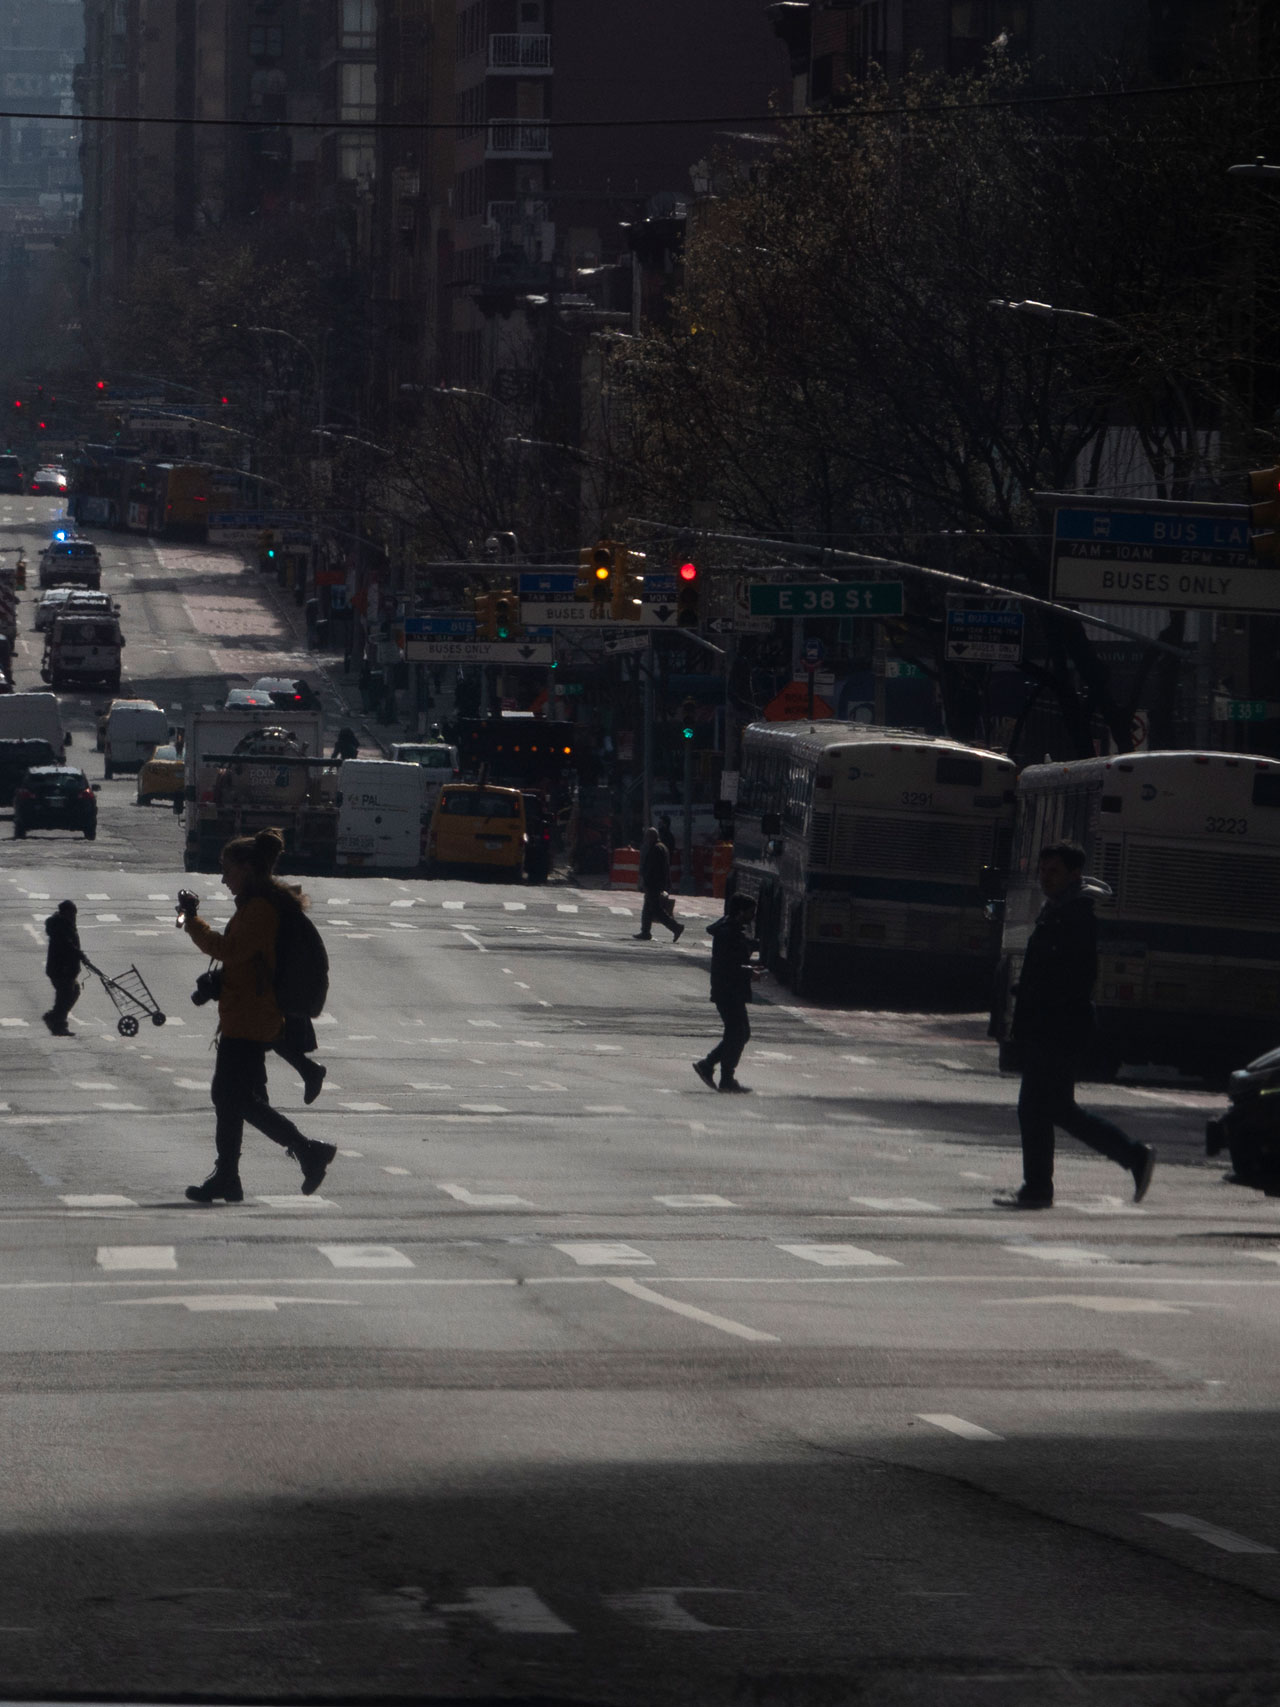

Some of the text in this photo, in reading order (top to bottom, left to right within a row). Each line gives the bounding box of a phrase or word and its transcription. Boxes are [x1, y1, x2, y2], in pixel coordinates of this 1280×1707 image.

[1153, 521, 1272, 545] BUS LAN
[1071, 543, 1101, 557] 7AM
[1116, 546, 1154, 559] 10AM
[1181, 551, 1213, 563] 2PM
[1102, 571, 1232, 594] BUSES ONLY
[778, 590, 872, 610] E 38 St
[546, 608, 585, 619] BUSES
[451, 621, 473, 632] BUS
[429, 644, 491, 655] BUSES ONLY
[901, 791, 935, 808] 3291
[1205, 816, 1248, 835] 3223
